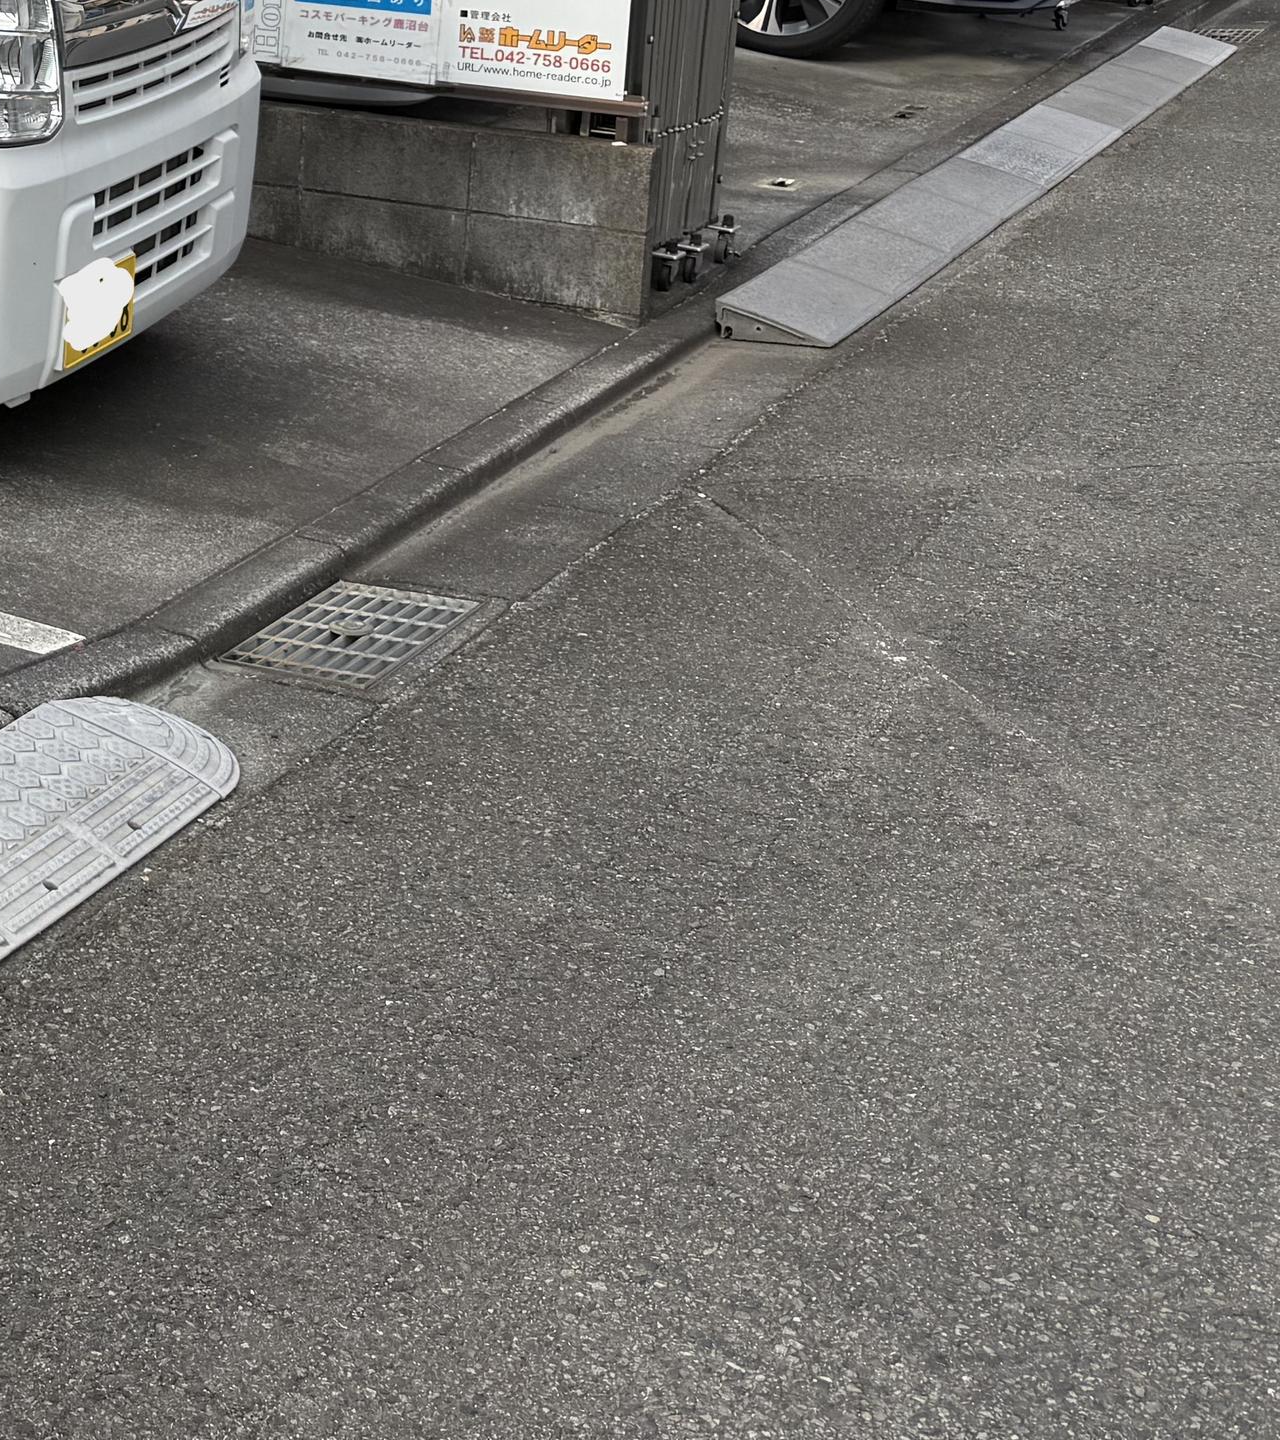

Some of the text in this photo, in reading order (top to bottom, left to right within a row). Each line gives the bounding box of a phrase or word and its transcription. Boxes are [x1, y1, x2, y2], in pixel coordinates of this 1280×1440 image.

[299, 9, 429, 33] コスモパーキング鹿沼台
[458, 45, 612, 73] TEL.042-758-0666
